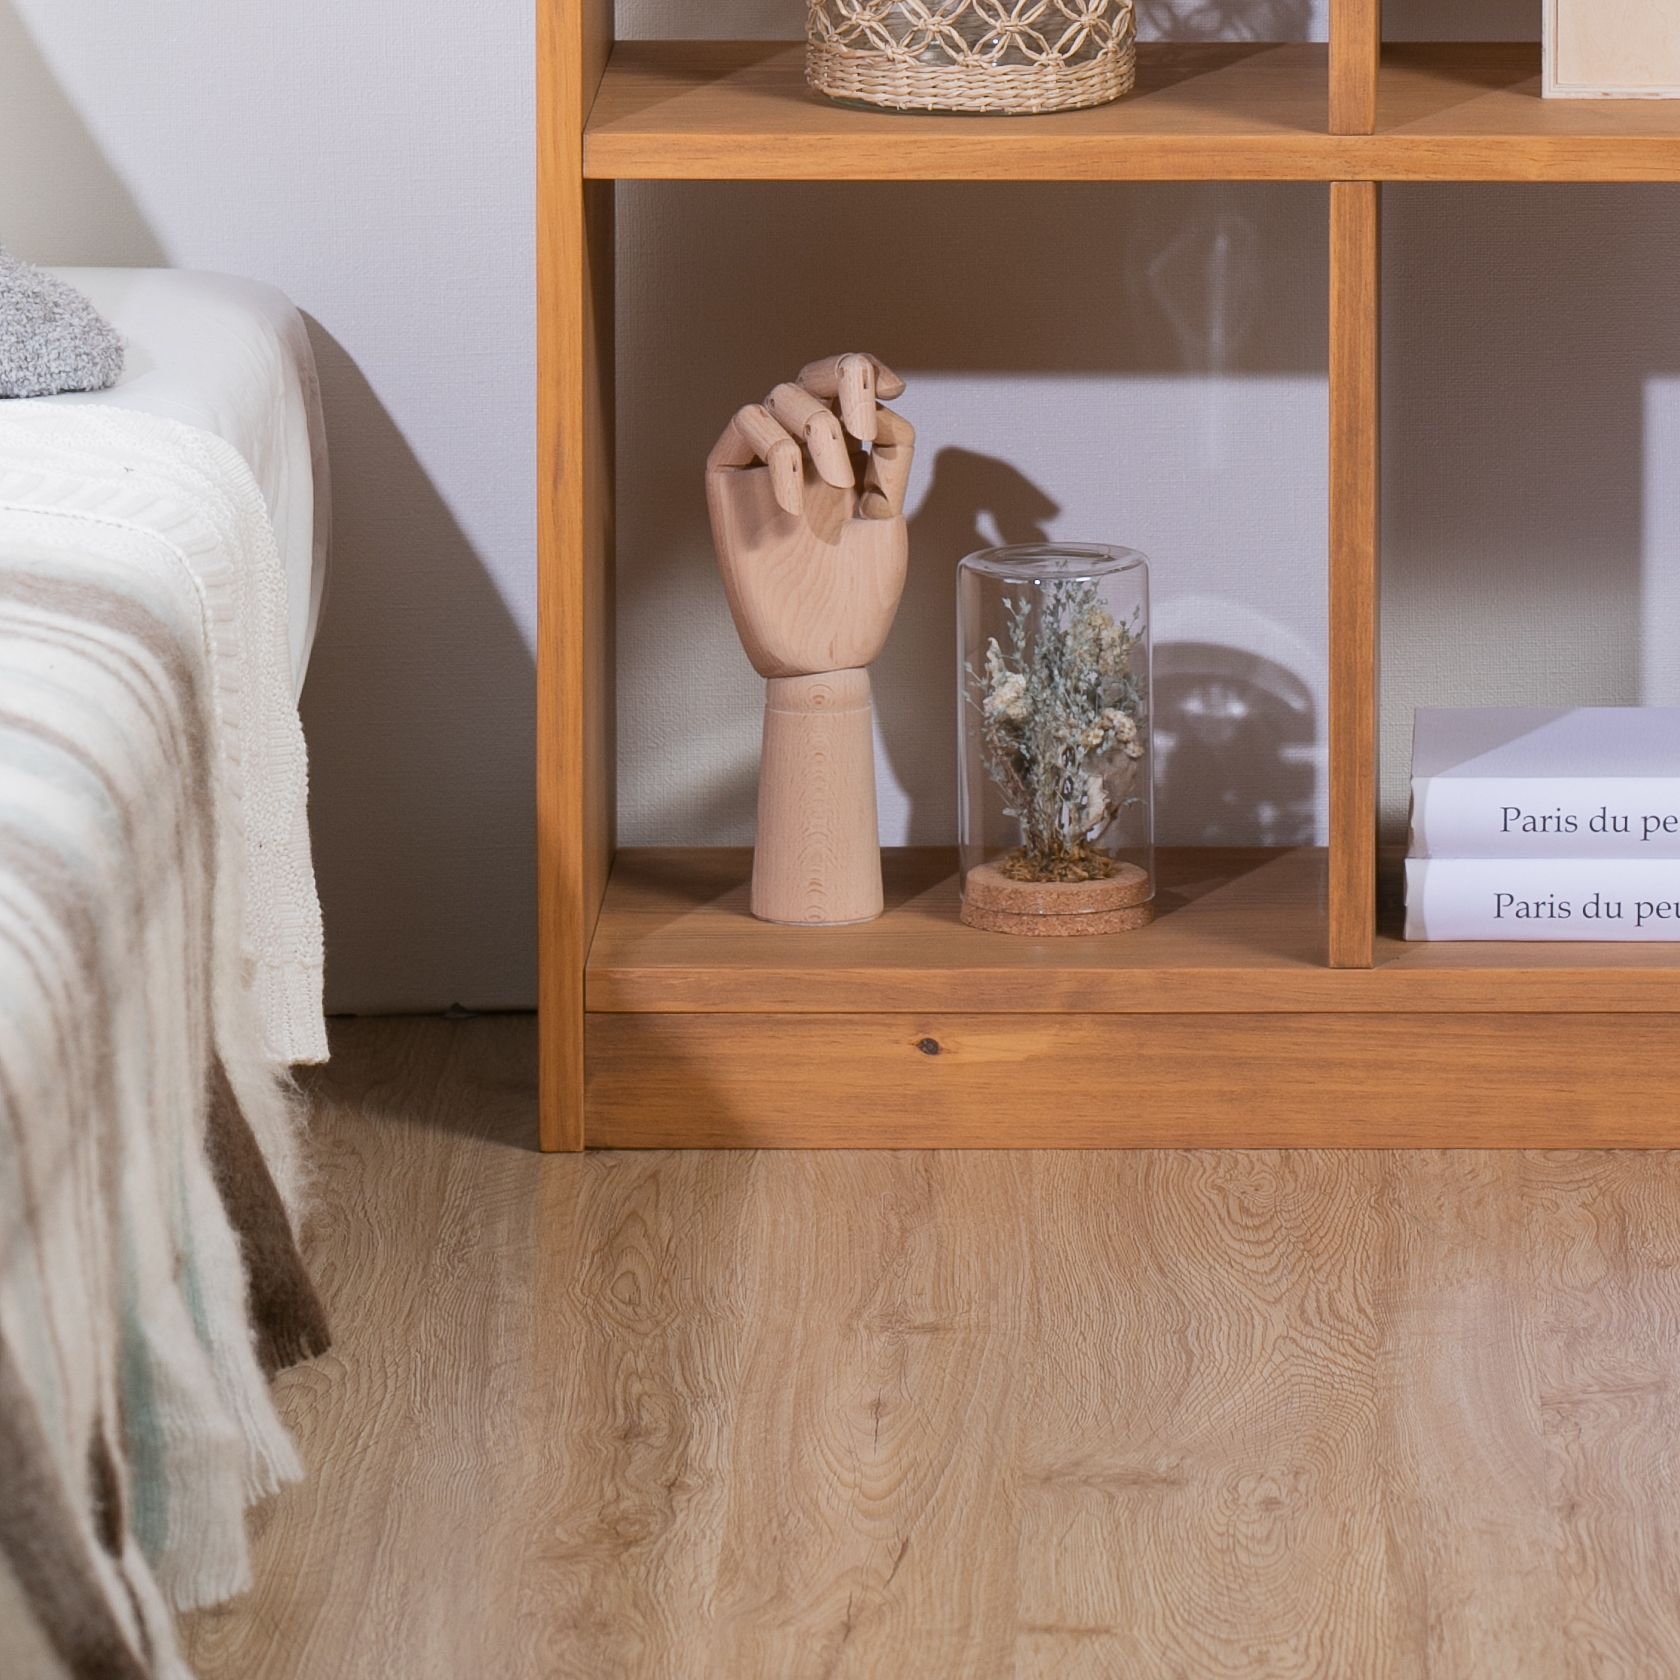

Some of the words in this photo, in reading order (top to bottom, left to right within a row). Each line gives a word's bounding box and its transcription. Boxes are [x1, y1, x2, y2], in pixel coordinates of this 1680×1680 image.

[1500, 806, 1578, 833] Paris
[1589, 806, 1631, 833] du
[1493, 893, 1572, 919] Paris
[1582, 893, 1624, 919] du
